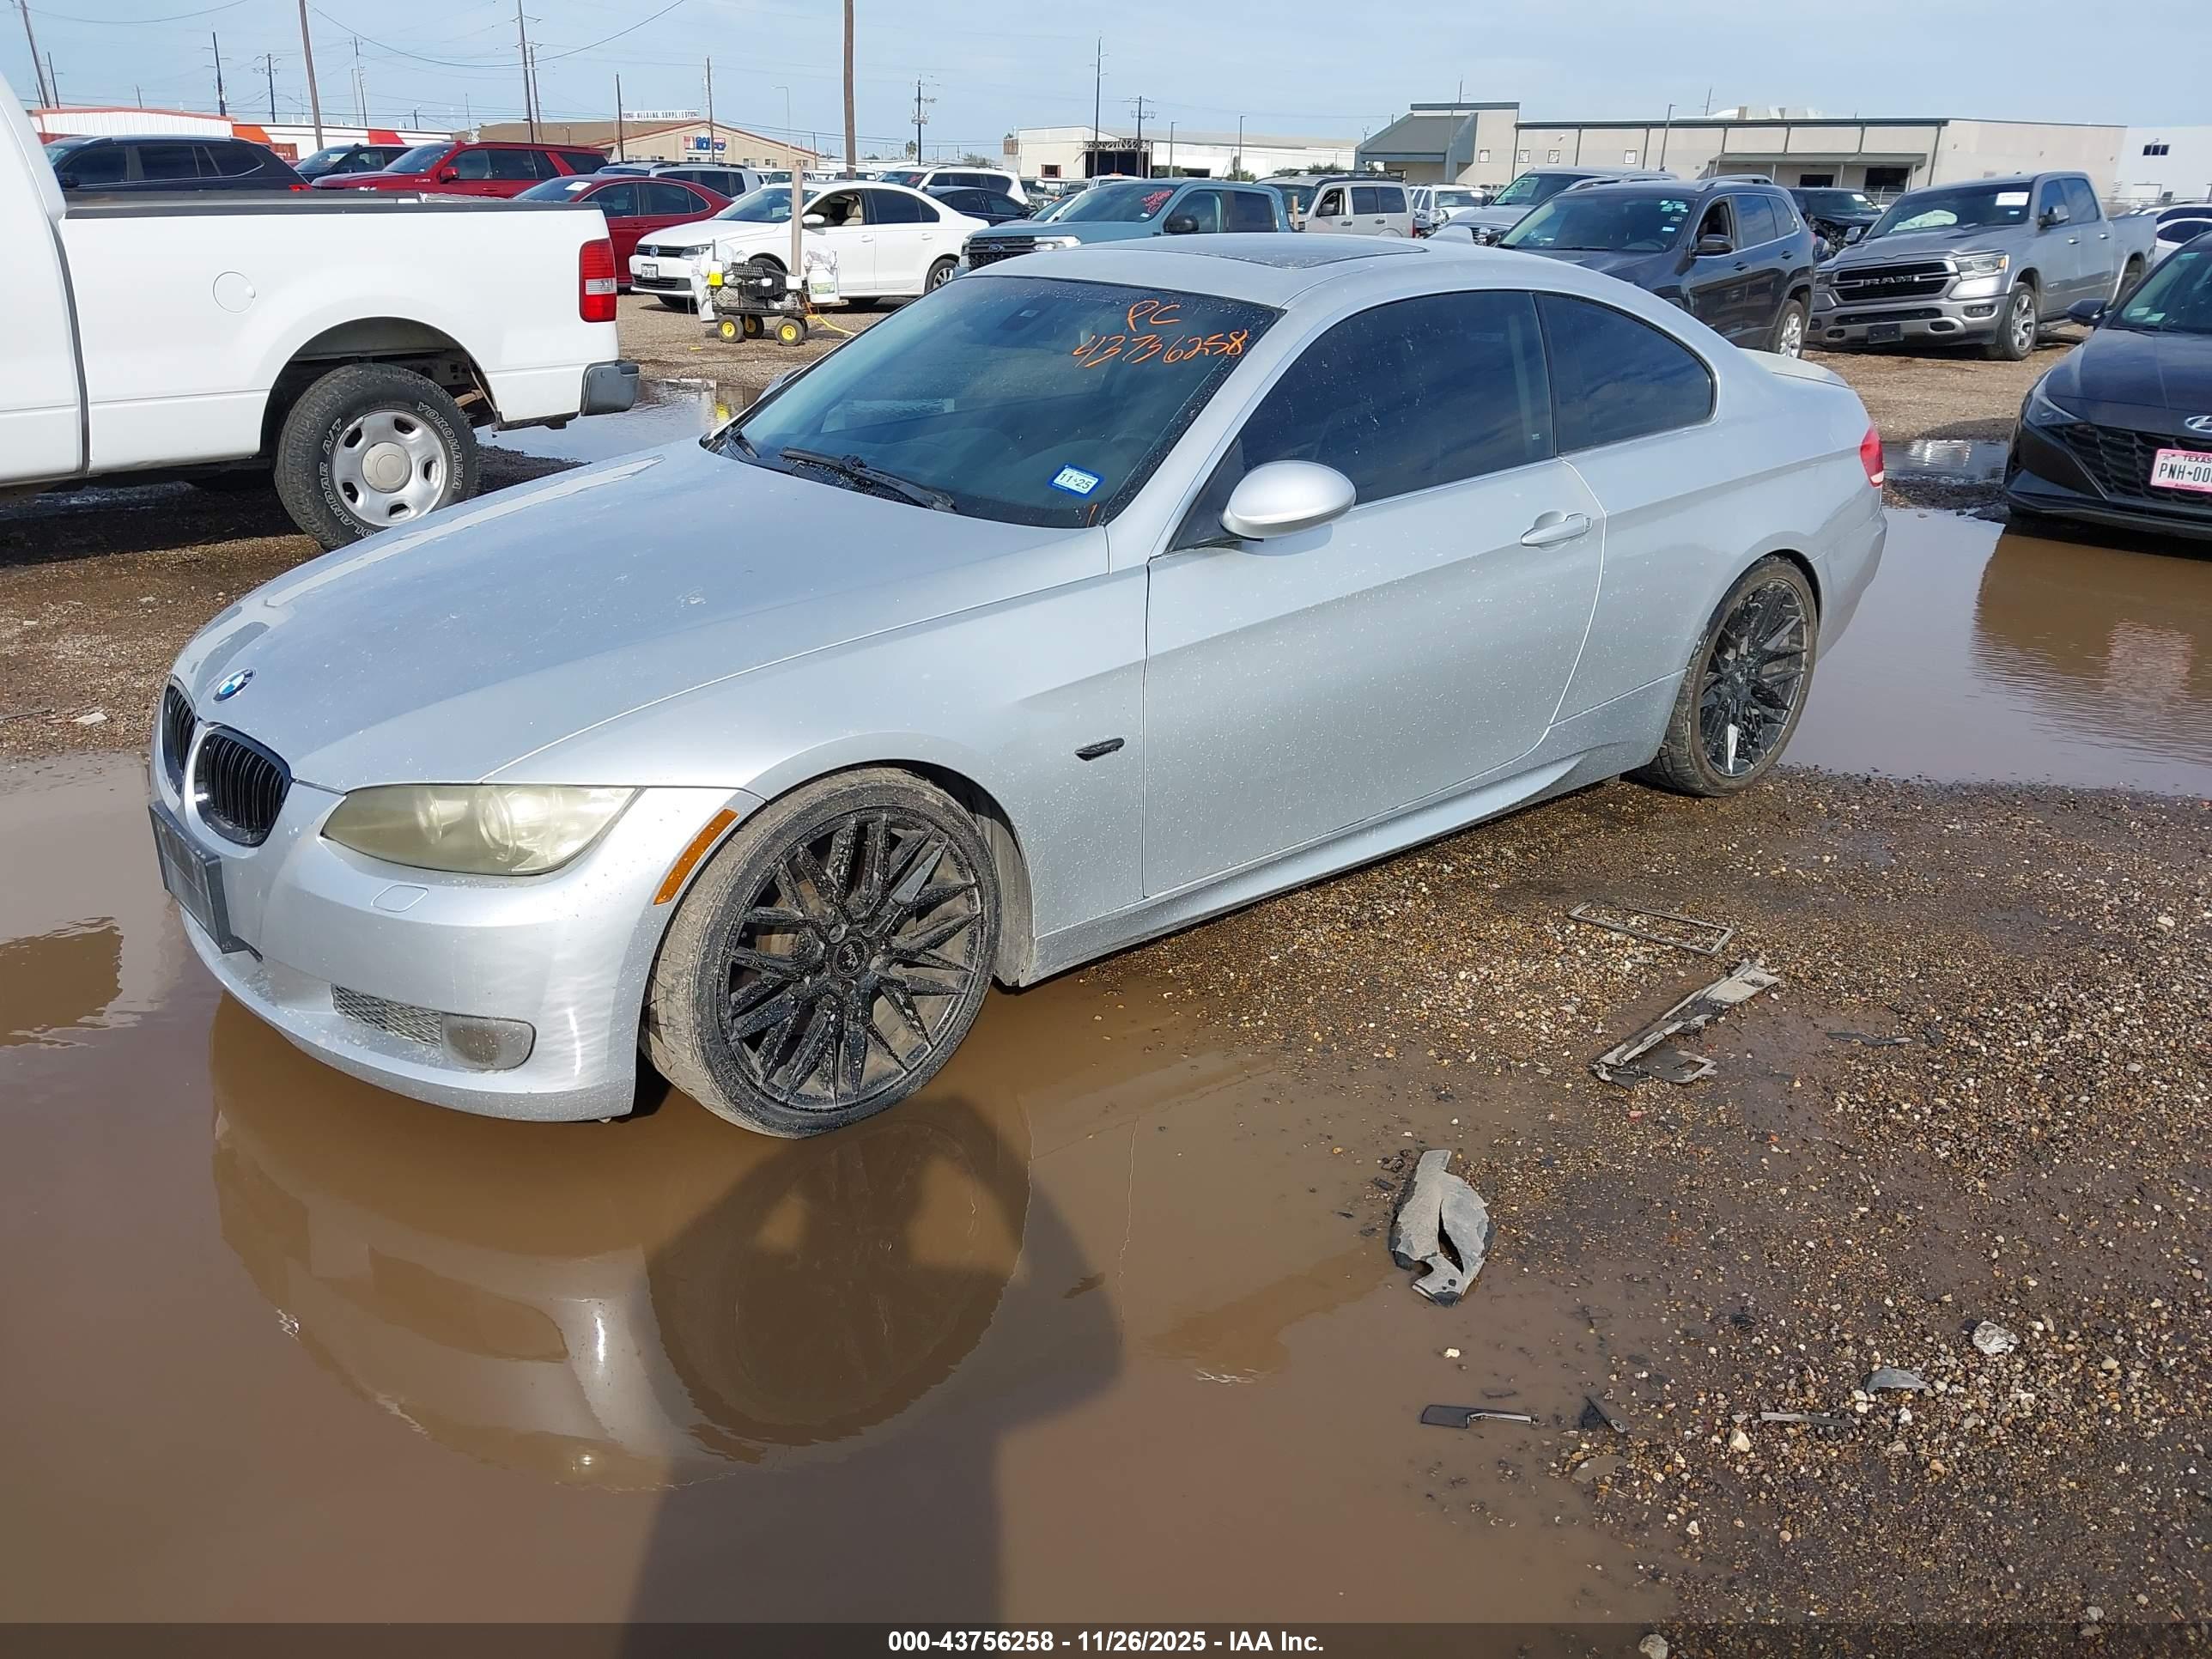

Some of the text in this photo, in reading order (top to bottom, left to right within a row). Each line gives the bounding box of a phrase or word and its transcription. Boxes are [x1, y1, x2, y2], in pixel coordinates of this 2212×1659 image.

[1127, 300, 1182, 331] PC
[322, 417, 342, 455] A/T
[417, 401, 464, 489] YOKOHAMA
[2183, 455, 2212, 464] TEXAS
